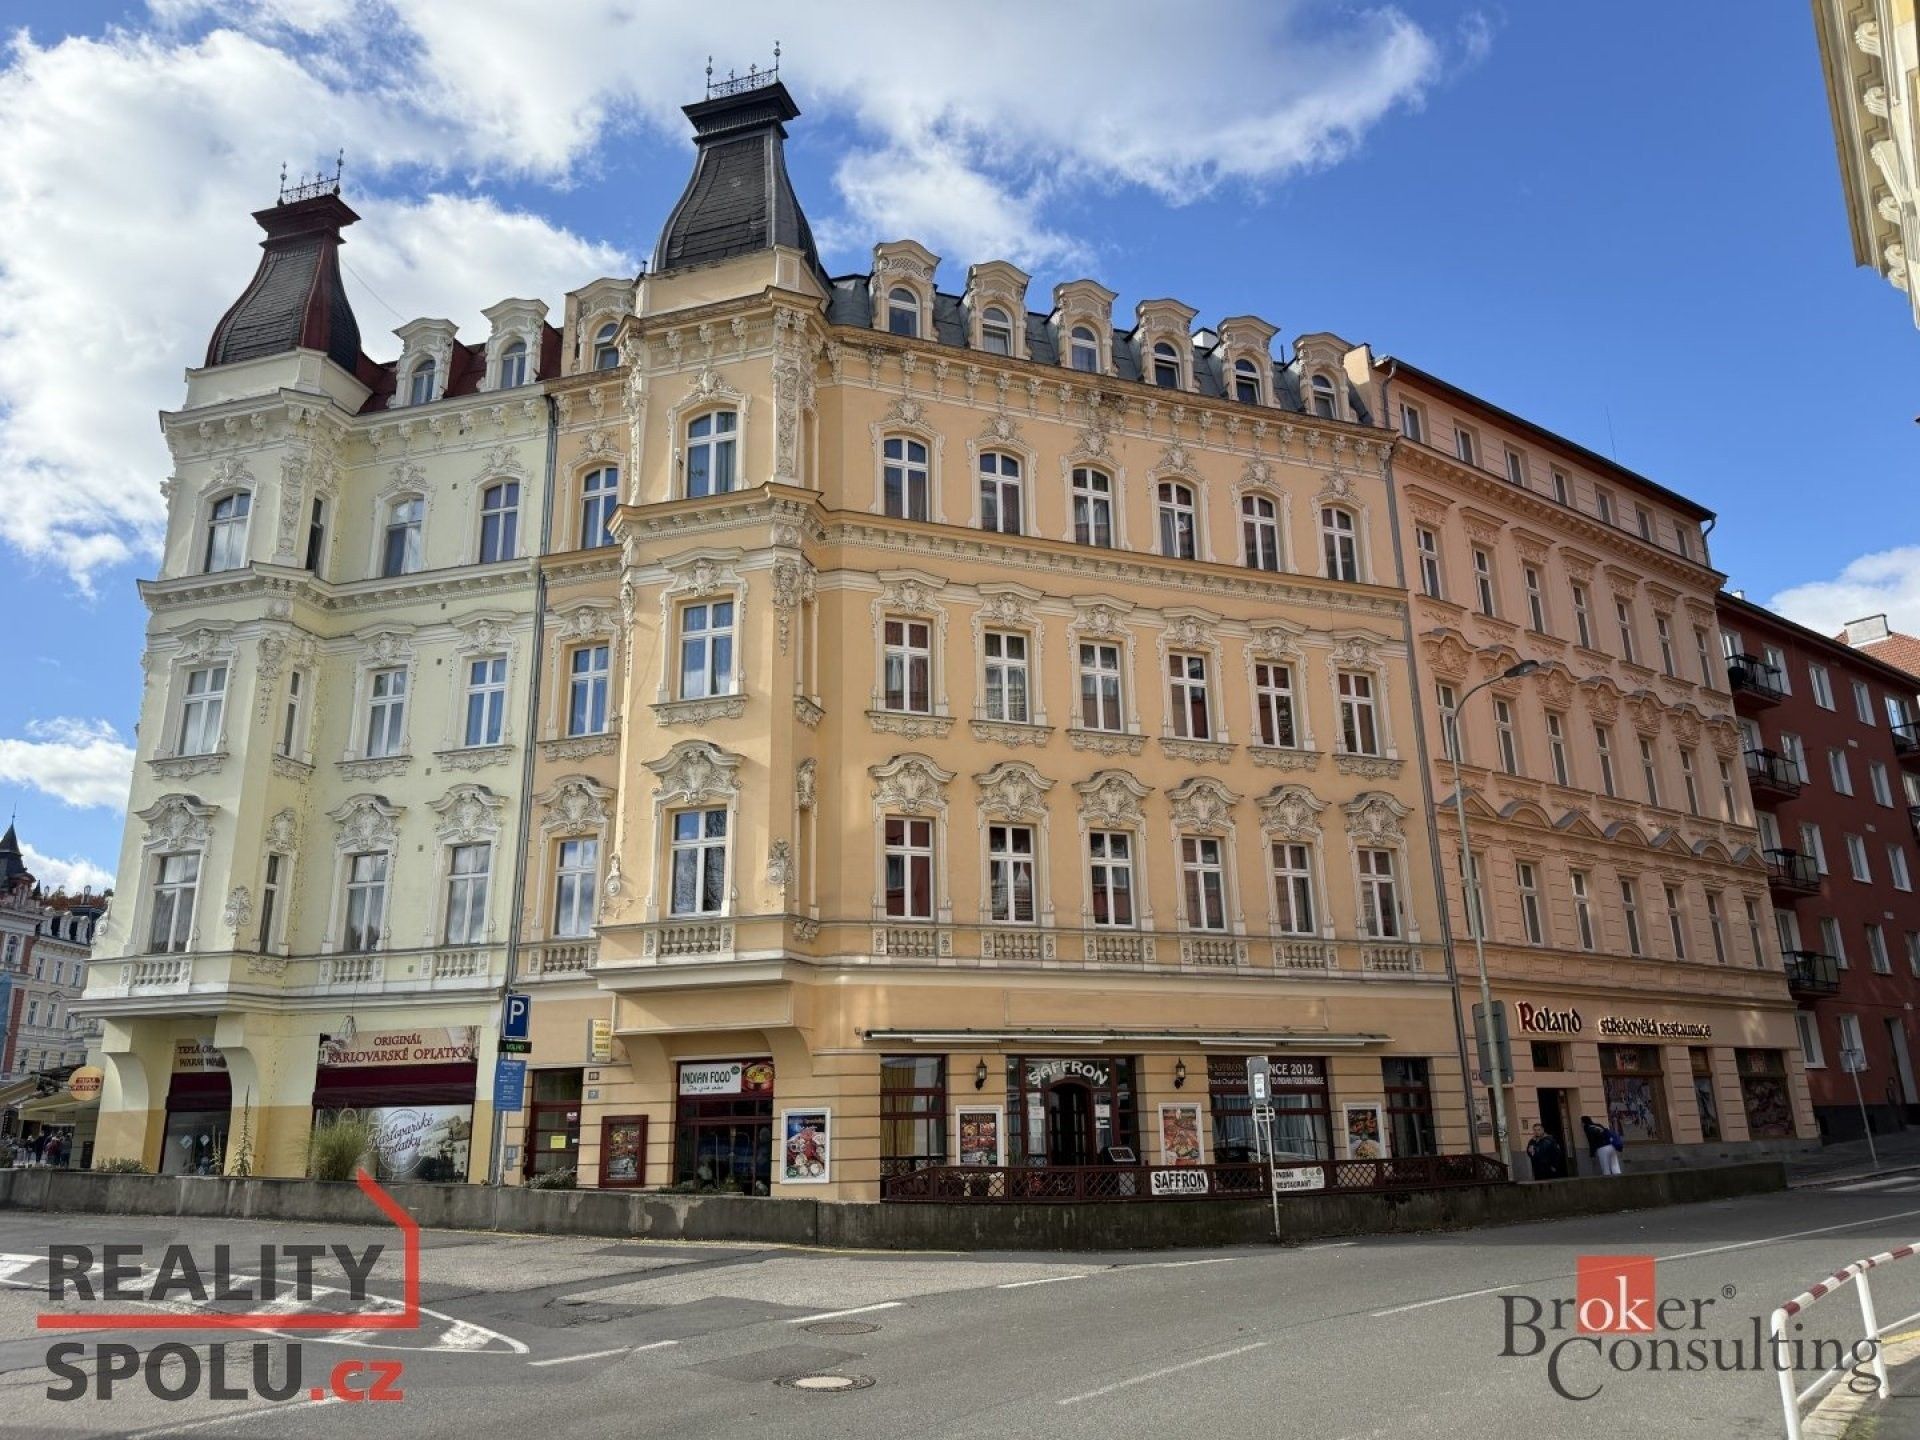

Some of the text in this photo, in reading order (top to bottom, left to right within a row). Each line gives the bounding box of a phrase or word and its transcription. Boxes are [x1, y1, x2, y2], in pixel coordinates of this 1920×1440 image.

[510, 1000, 524, 1024] P
[1518, 1002, 1582, 1033] Roland
[374, 1033, 422, 1046] ORIGINÁL
[328, 1047, 399, 1063] KARLOVARSKÉ
[1028, 1060, 1108, 1085] SAFFRON
[1290, 1063, 1314, 1075] 2012
[682, 1071, 709, 1084] INDIAN
[710, 1070, 732, 1083] FOOD
[1154, 1173, 1206, 1188] SAFFRON
